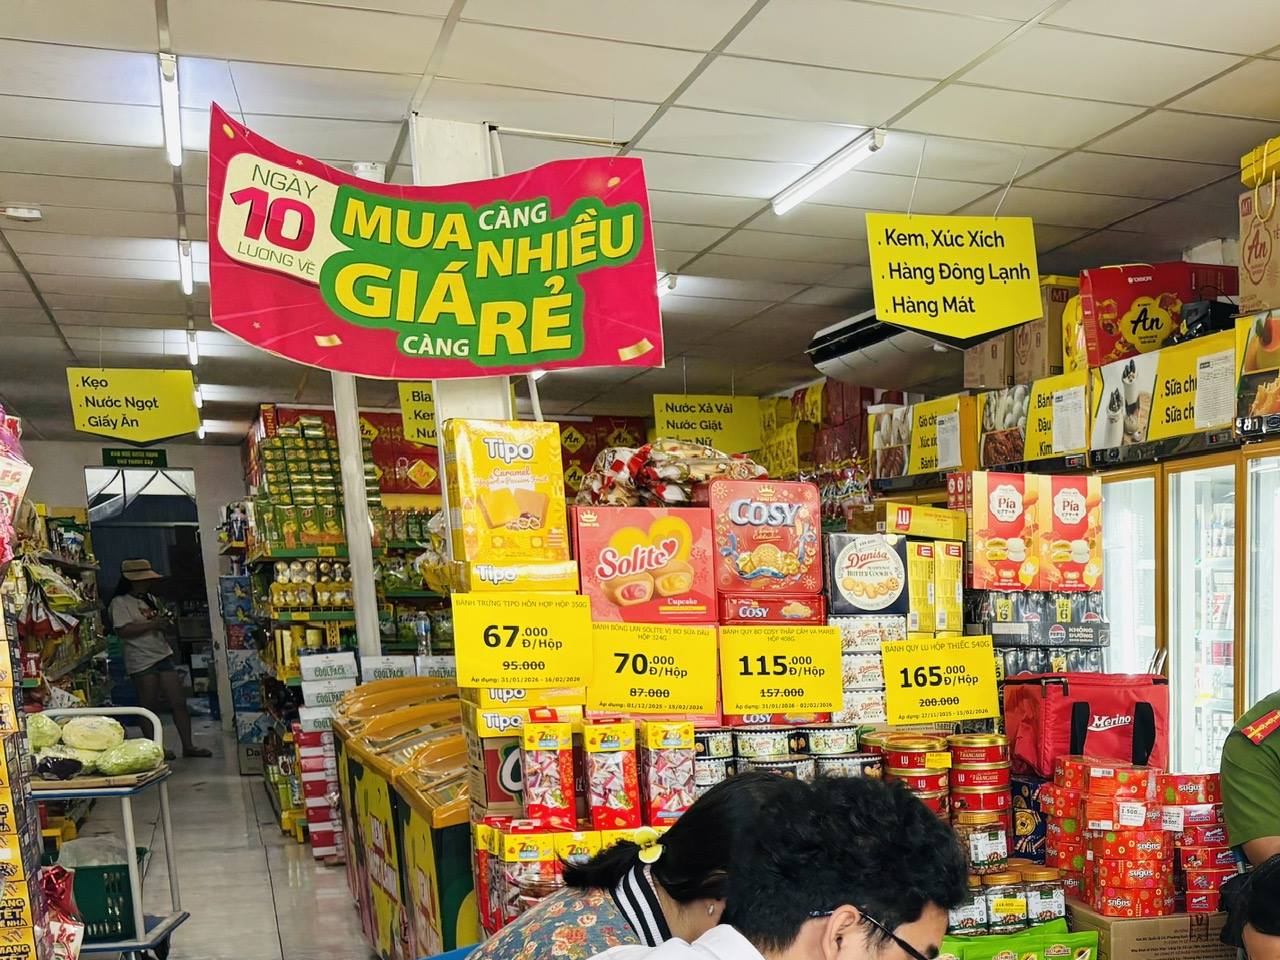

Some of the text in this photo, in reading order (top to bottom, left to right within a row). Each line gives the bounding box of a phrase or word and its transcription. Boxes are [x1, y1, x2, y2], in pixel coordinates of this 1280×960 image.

[252, 164, 318, 199] NGÀY
[230, 187, 315, 252] 10
[342, 198, 547, 253] MUA CÀNG
[477, 213, 634, 279] NHIỀU
[886, 229, 1004, 249] Kem, Xúc Xích
[889, 262, 1030, 285] Hàng Đông Lạnh
[335, 260, 571, 355] GIÁ RẺ
[893, 296, 975, 317] Hàng Mát
[403, 334, 469, 356] CÀNG
[81, 376, 108, 389] Kẹo
[1165, 379, 1183, 396] Sữa
[85, 396, 159, 410] Nước Ngọt
[412, 391, 431, 402] Bia
[666, 403, 733, 413] Nước Xả Vải
[1165, 407, 1183, 423] Sữa
[88, 413, 139, 430] Giấy Ăn
[666, 420, 722, 431] Nước Giặt
[483, 437, 534, 463] Tipo
[999, 496, 1016, 509] Pía
[1062, 500, 1080, 512] Pía
[729, 500, 799, 526] COSY
[596, 542, 668, 580] Solite
[848, 550, 889, 569] Danisa
[739, 607, 769, 617] COSY
[483, 625, 520, 647] 67
[1069, 626, 1093, 634] KHÔNG
[503, 661, 545, 670] 95.000
[614, 653, 648, 674] 70
[739, 656, 787, 675] 115
[900, 666, 942, 688] 165
[630, 688, 670, 698] 87.000
[760, 689, 804, 697] 157.000
[920, 697, 959, 707] 200.000
[1092, 714, 1131, 728] Merino
